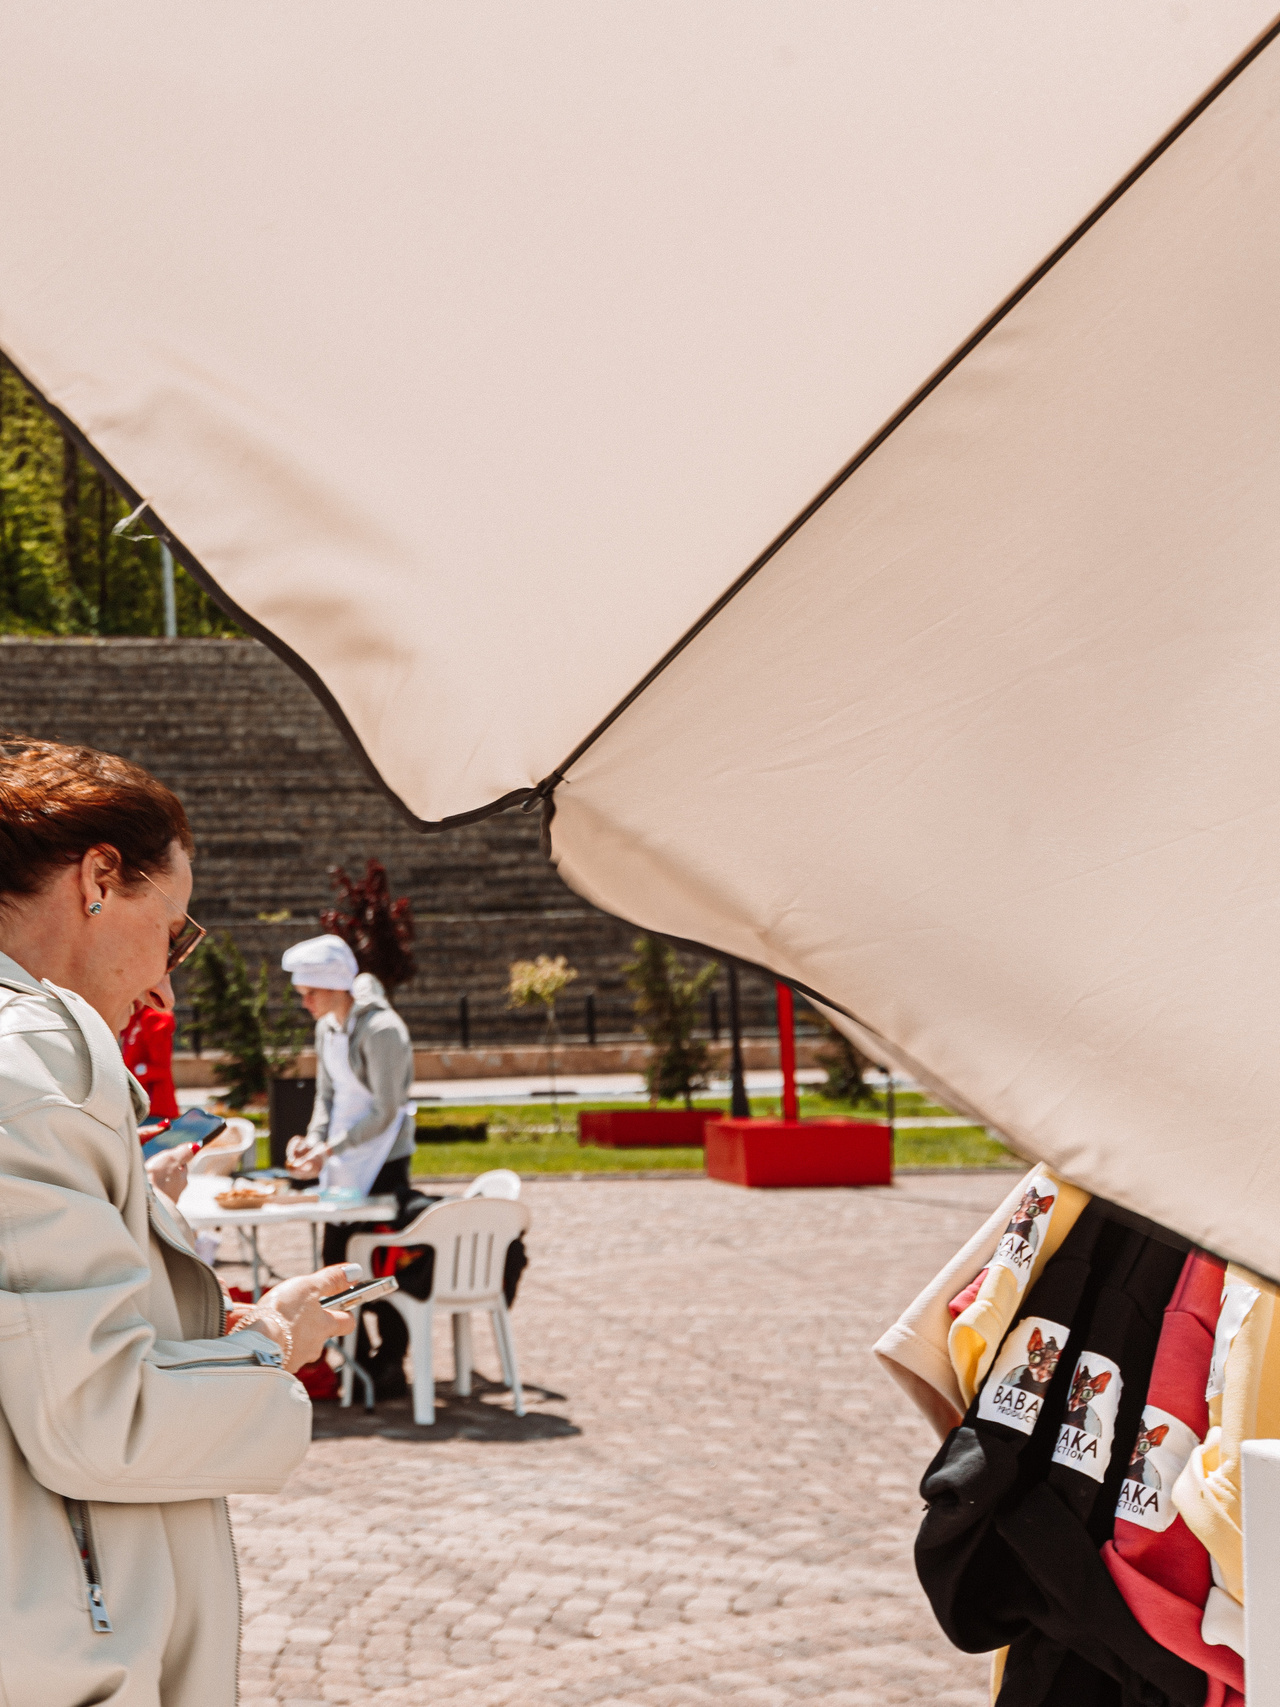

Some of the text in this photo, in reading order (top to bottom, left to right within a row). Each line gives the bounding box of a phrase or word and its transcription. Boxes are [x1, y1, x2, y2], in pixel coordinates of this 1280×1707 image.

[1000, 1236, 1033, 1269] AKA
[993, 1386, 1039, 1418] BABA
[1054, 1445, 1084, 1461] CTION
